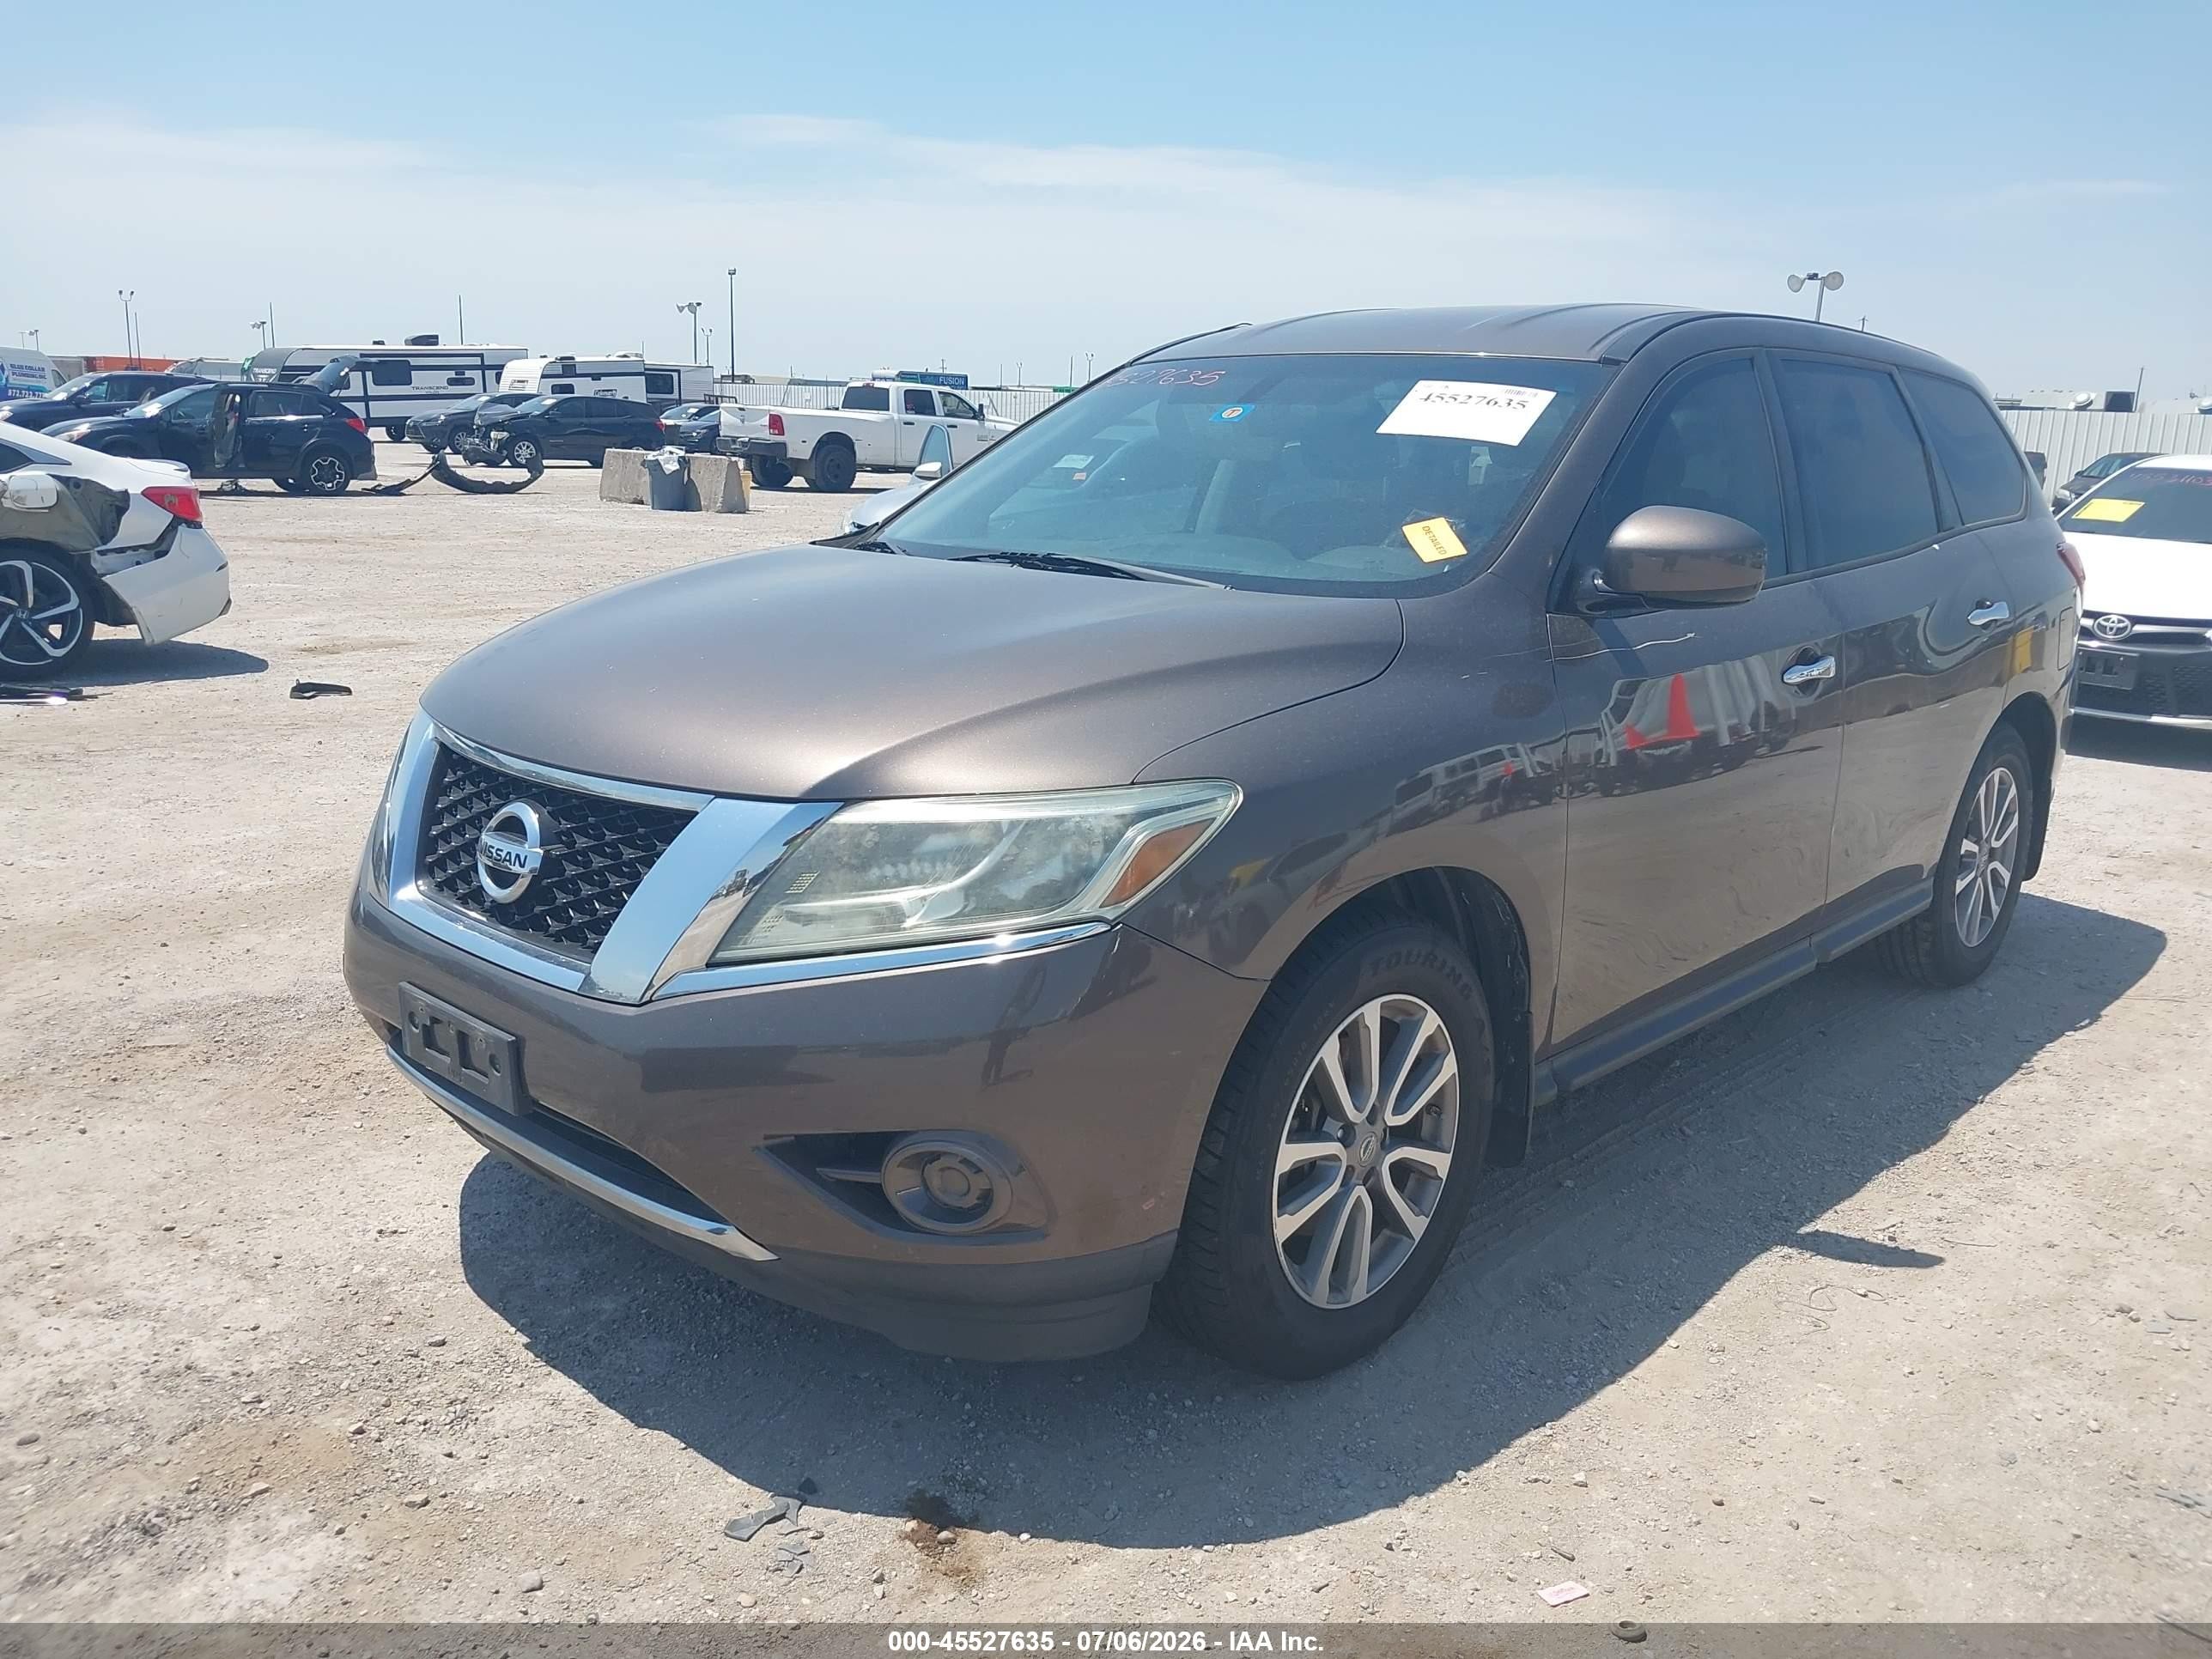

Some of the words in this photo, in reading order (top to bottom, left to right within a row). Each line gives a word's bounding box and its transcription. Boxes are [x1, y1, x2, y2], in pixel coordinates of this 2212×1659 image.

[939, 376, 964, 386] FUSION
[1419, 392, 1530, 410] 45527635
[1422, 526, 1448, 556] DETAILED
[479, 840, 528, 869] NISSAN
